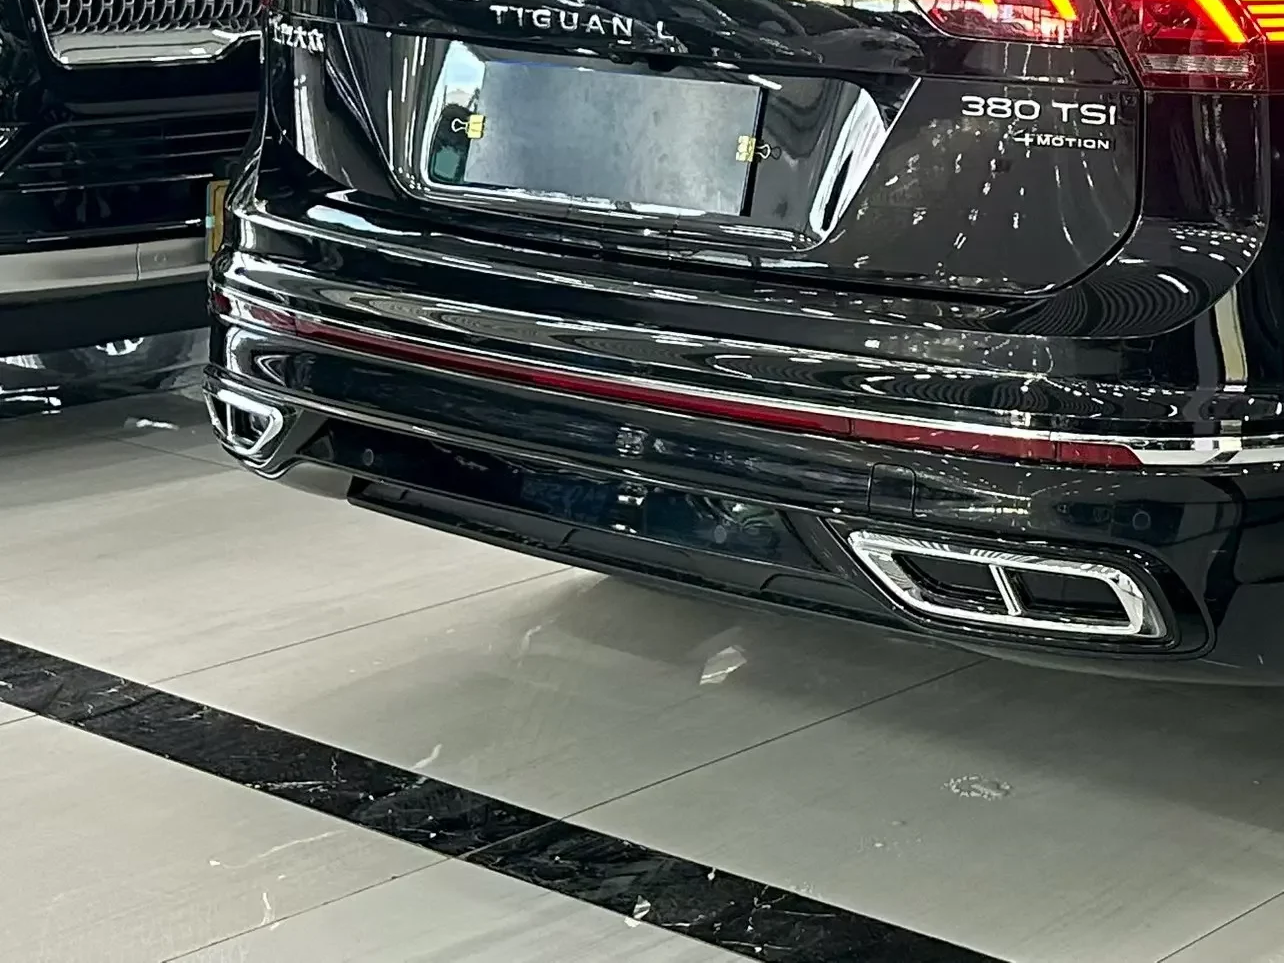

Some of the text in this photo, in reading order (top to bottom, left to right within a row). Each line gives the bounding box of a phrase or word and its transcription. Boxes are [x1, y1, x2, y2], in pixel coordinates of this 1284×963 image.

[489, 4, 675, 39] TIGUAN L
[961, 95, 1117, 126] 380 TSI
